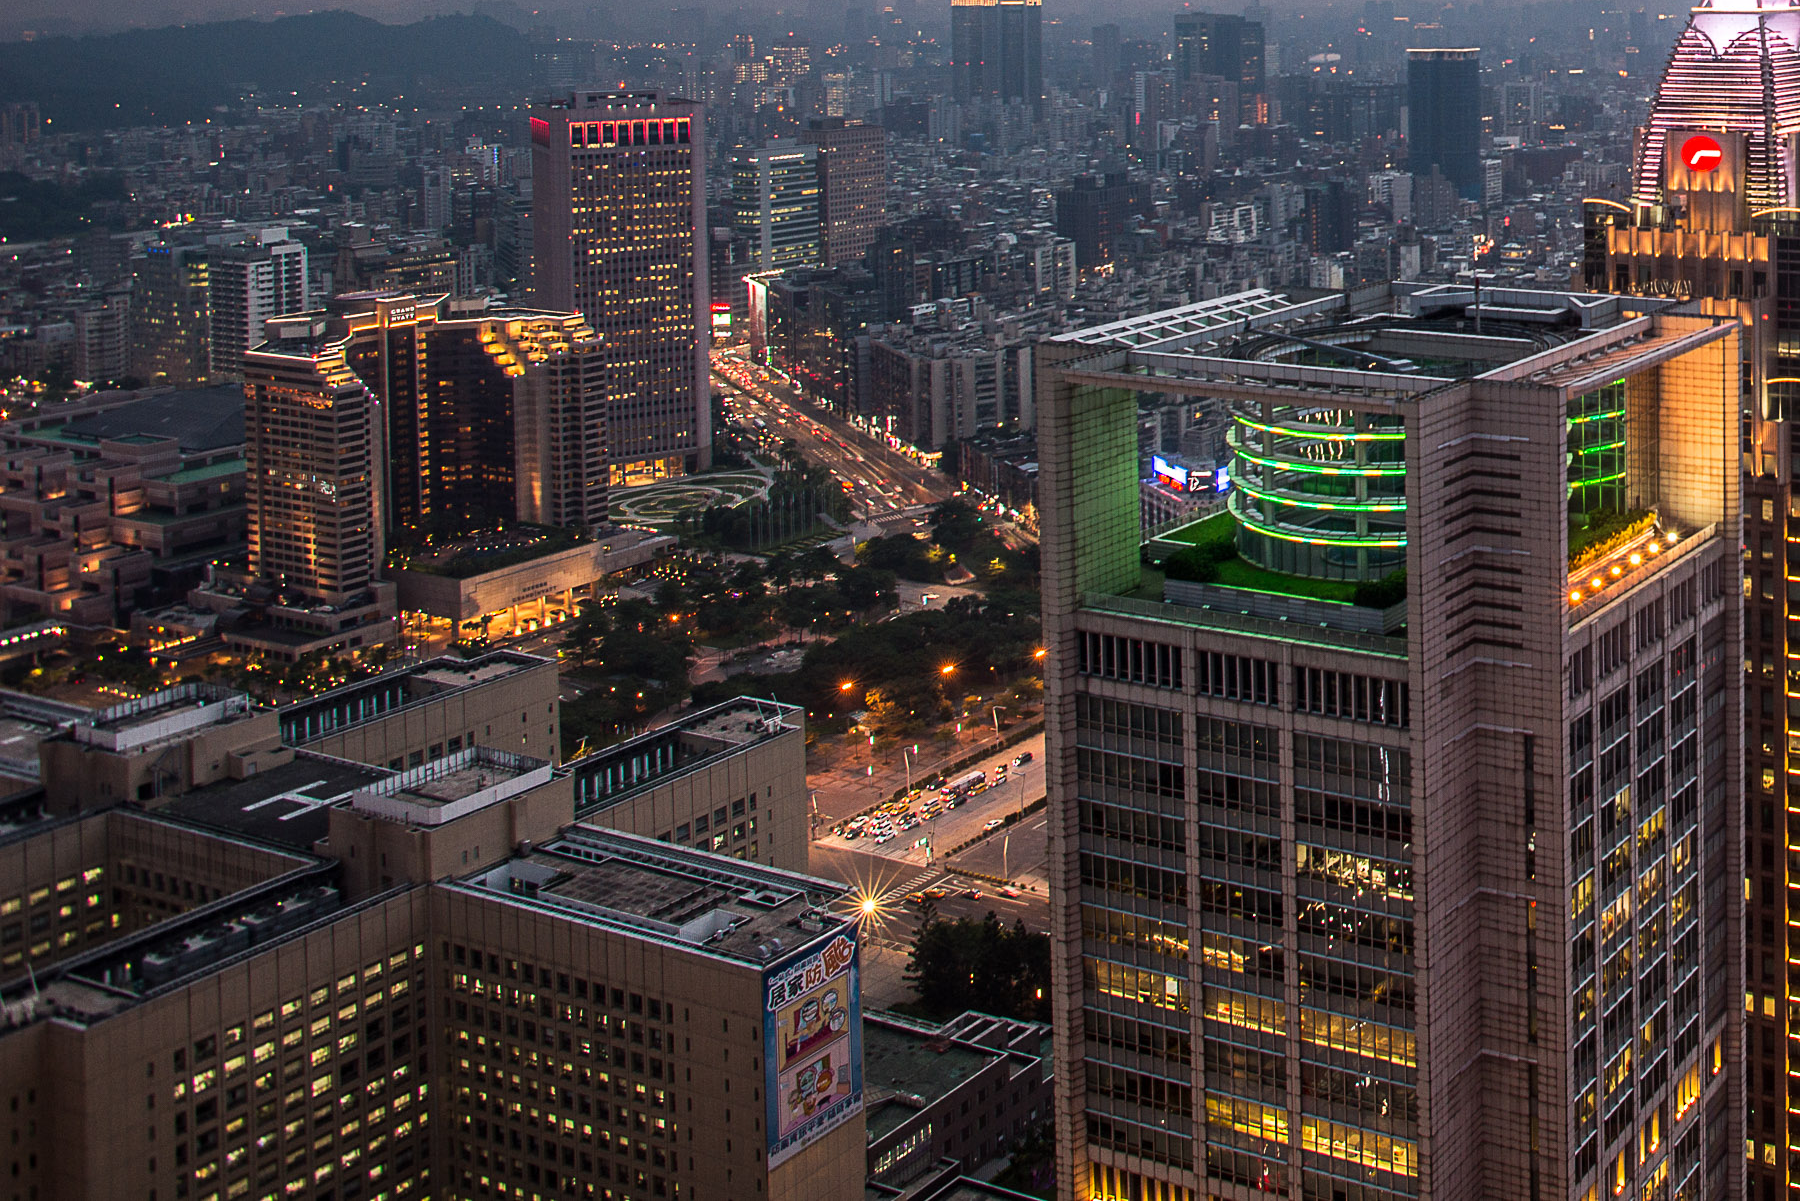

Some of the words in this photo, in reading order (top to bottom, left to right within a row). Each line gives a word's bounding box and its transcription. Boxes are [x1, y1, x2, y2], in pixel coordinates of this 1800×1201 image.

[391, 306, 415, 315] GRAND
[391, 313, 415, 321] HYATT
[768, 936, 855, 1011] 居家防颱
